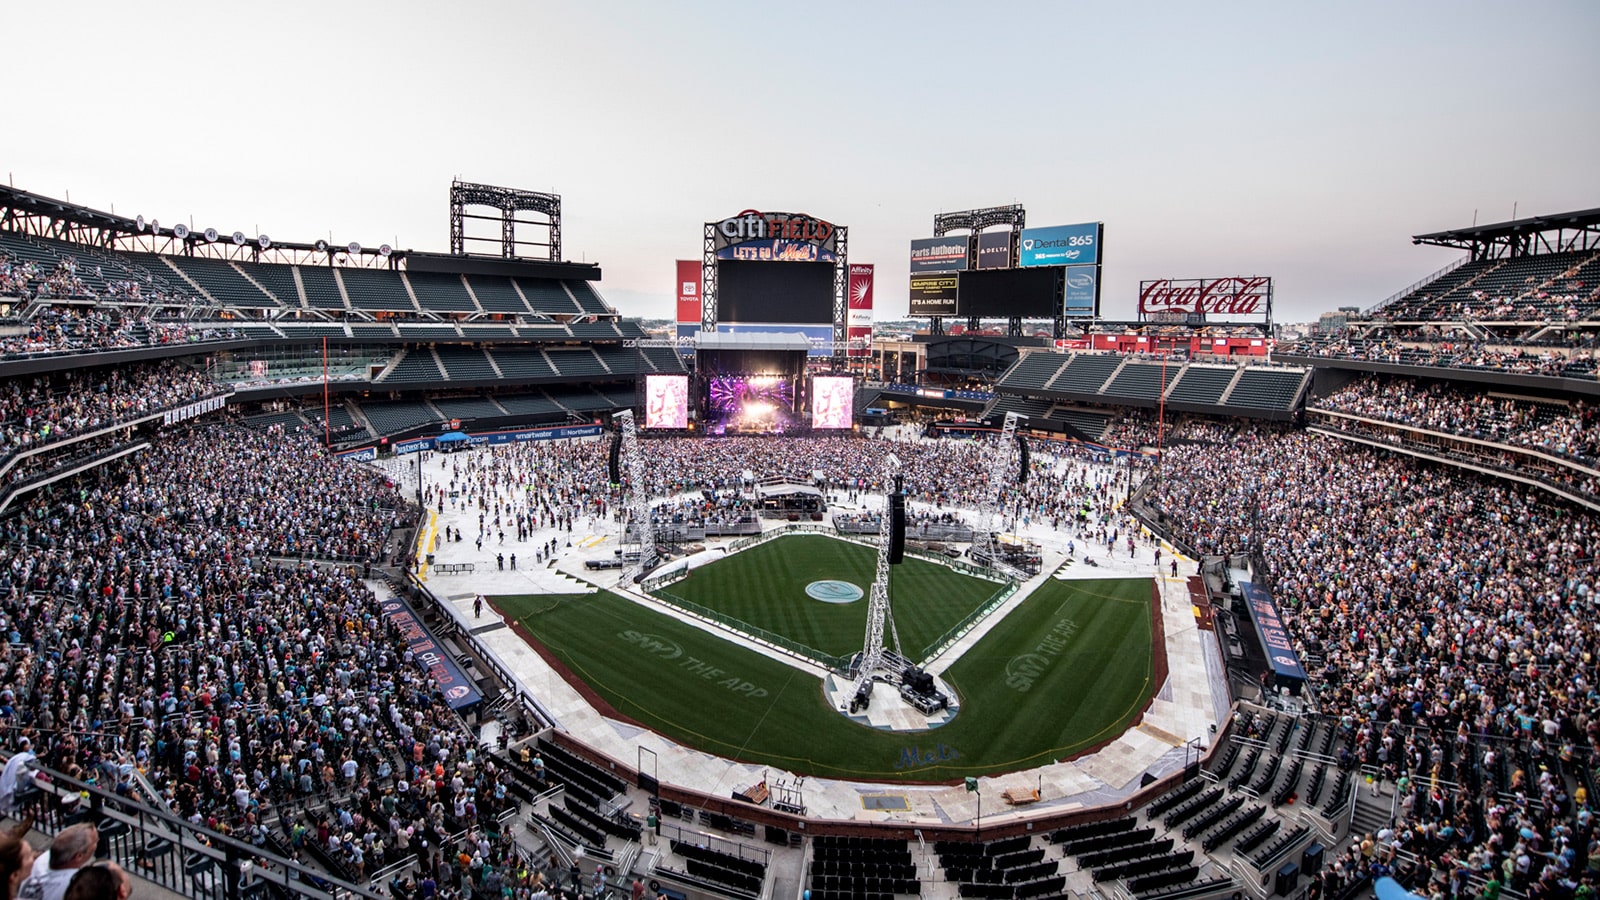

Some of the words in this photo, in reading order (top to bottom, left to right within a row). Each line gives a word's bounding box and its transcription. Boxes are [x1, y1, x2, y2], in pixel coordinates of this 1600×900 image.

[177, 227, 186, 235] 31
[721, 215, 764, 238] citi
[768, 219, 832, 239] FIELD
[208, 231, 216, 239] 41
[733, 247, 758, 258] LET'S
[759, 248, 771, 259] GO
[779, 243, 810, 259] Mets
[911, 248, 930, 258] Parts
[930, 245, 967, 256] Authority
[986, 246, 1008, 254] DELTA
[850, 266, 873, 275] Affinity
[515, 430, 553, 440] smartwater
[567, 427, 596, 436] Northwell
[679, 656, 726, 680] THE
[717, 677, 769, 698] APP
[893, 742, 961, 769] Mets
